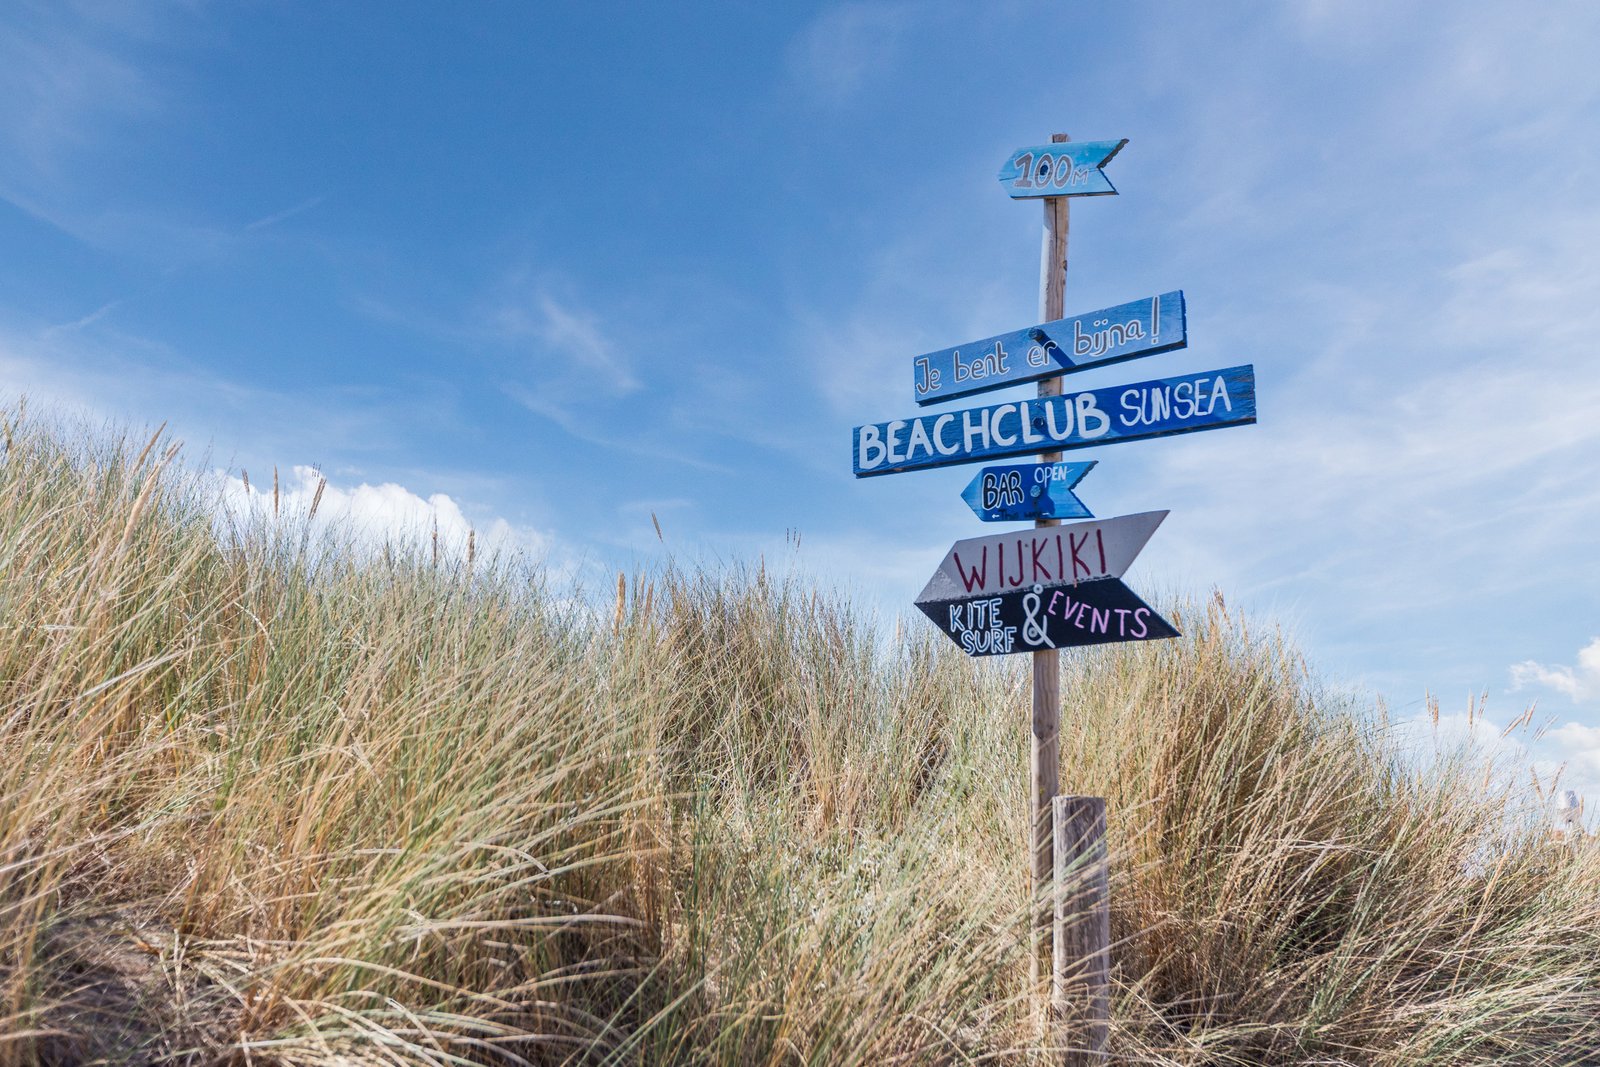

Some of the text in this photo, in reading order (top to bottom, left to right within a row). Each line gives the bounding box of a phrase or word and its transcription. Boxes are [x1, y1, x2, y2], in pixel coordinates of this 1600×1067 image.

[915, 357, 942, 395] Je
[953, 342, 1010, 382] bent
[1027, 339, 1057, 368] er
[858, 392, 1111, 470] BEACHCLUB
[981, 465, 1068, 511] BAR OPEN
[953, 528, 1107, 593] WIJKIKI
[949, 583, 1150, 649] KITE & EVENTS
[960, 626, 1017, 656] SURF
